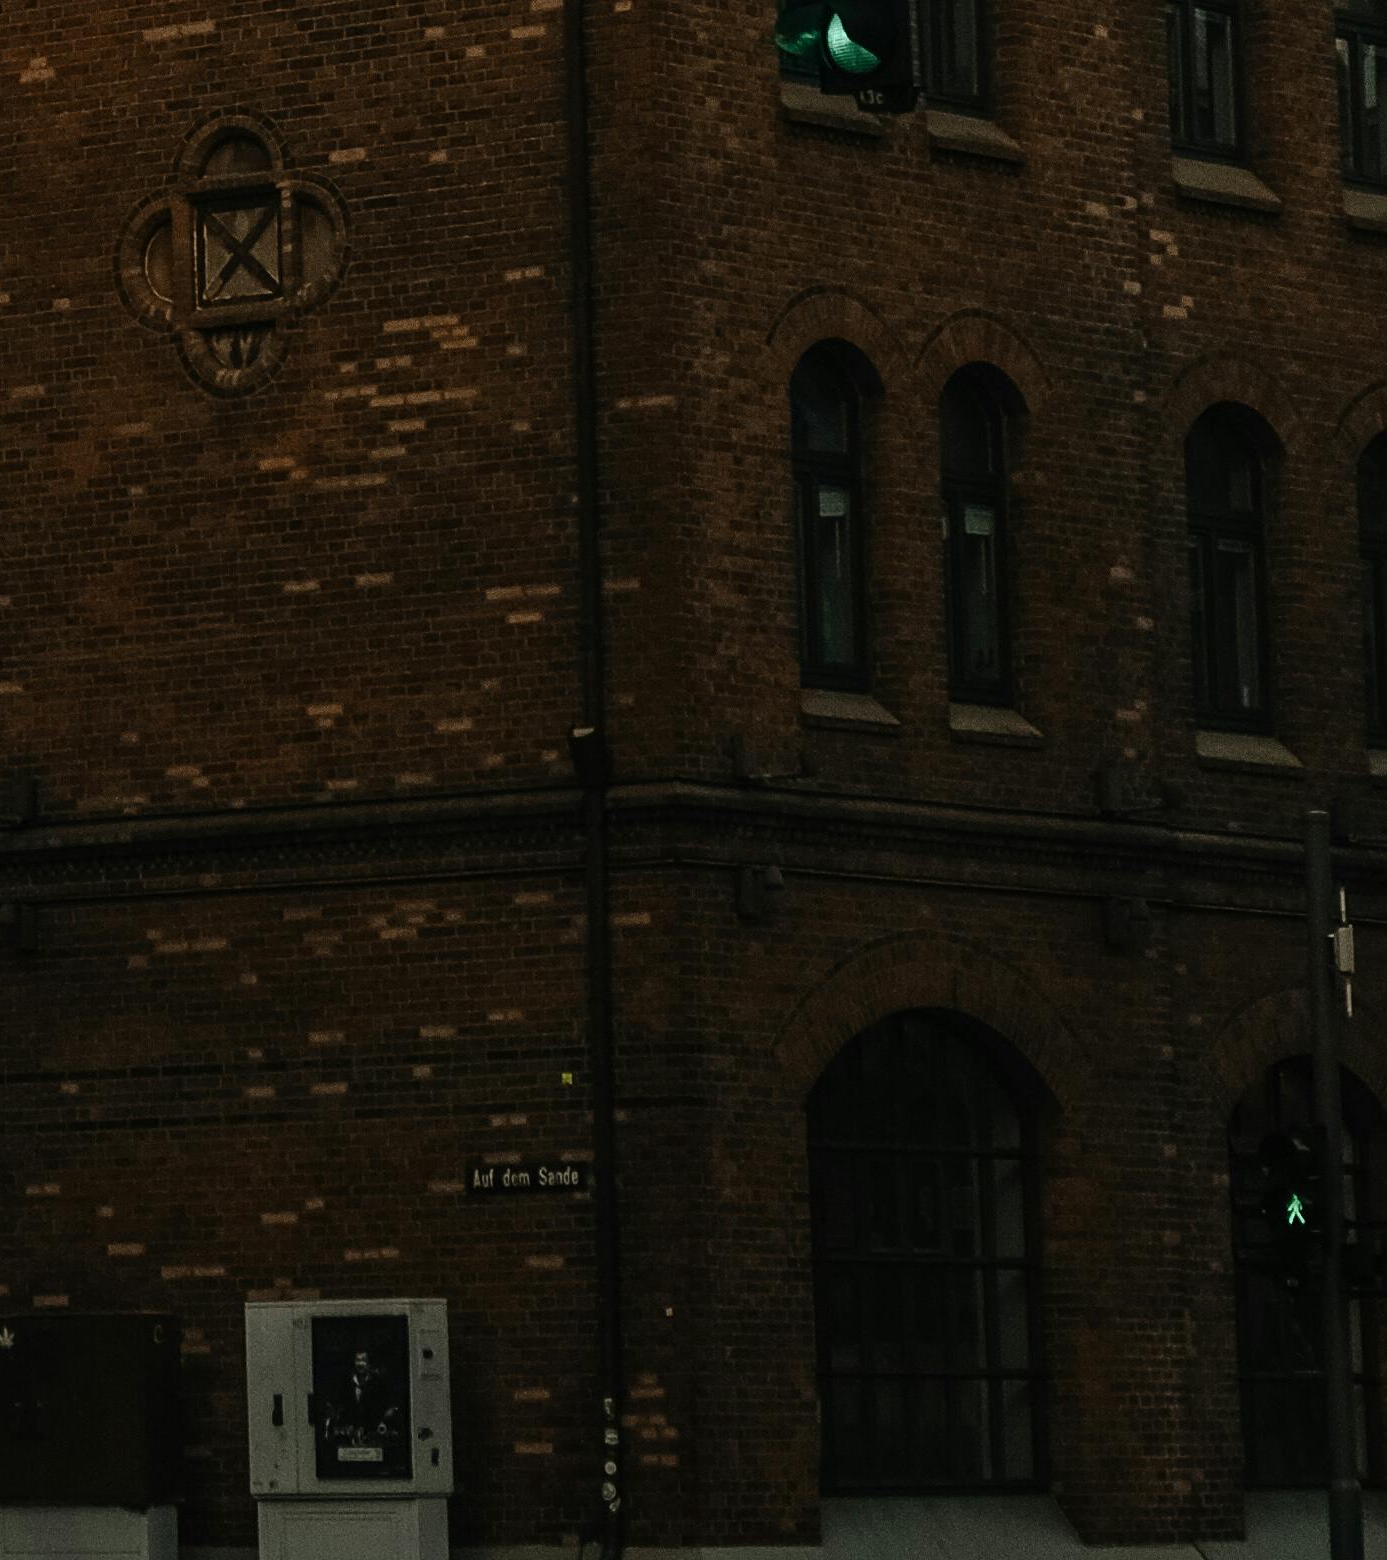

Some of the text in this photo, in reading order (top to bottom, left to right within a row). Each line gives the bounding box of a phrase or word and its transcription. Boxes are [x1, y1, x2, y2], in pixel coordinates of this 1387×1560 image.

[473, 1165, 579, 1188] Auf dem Sande
